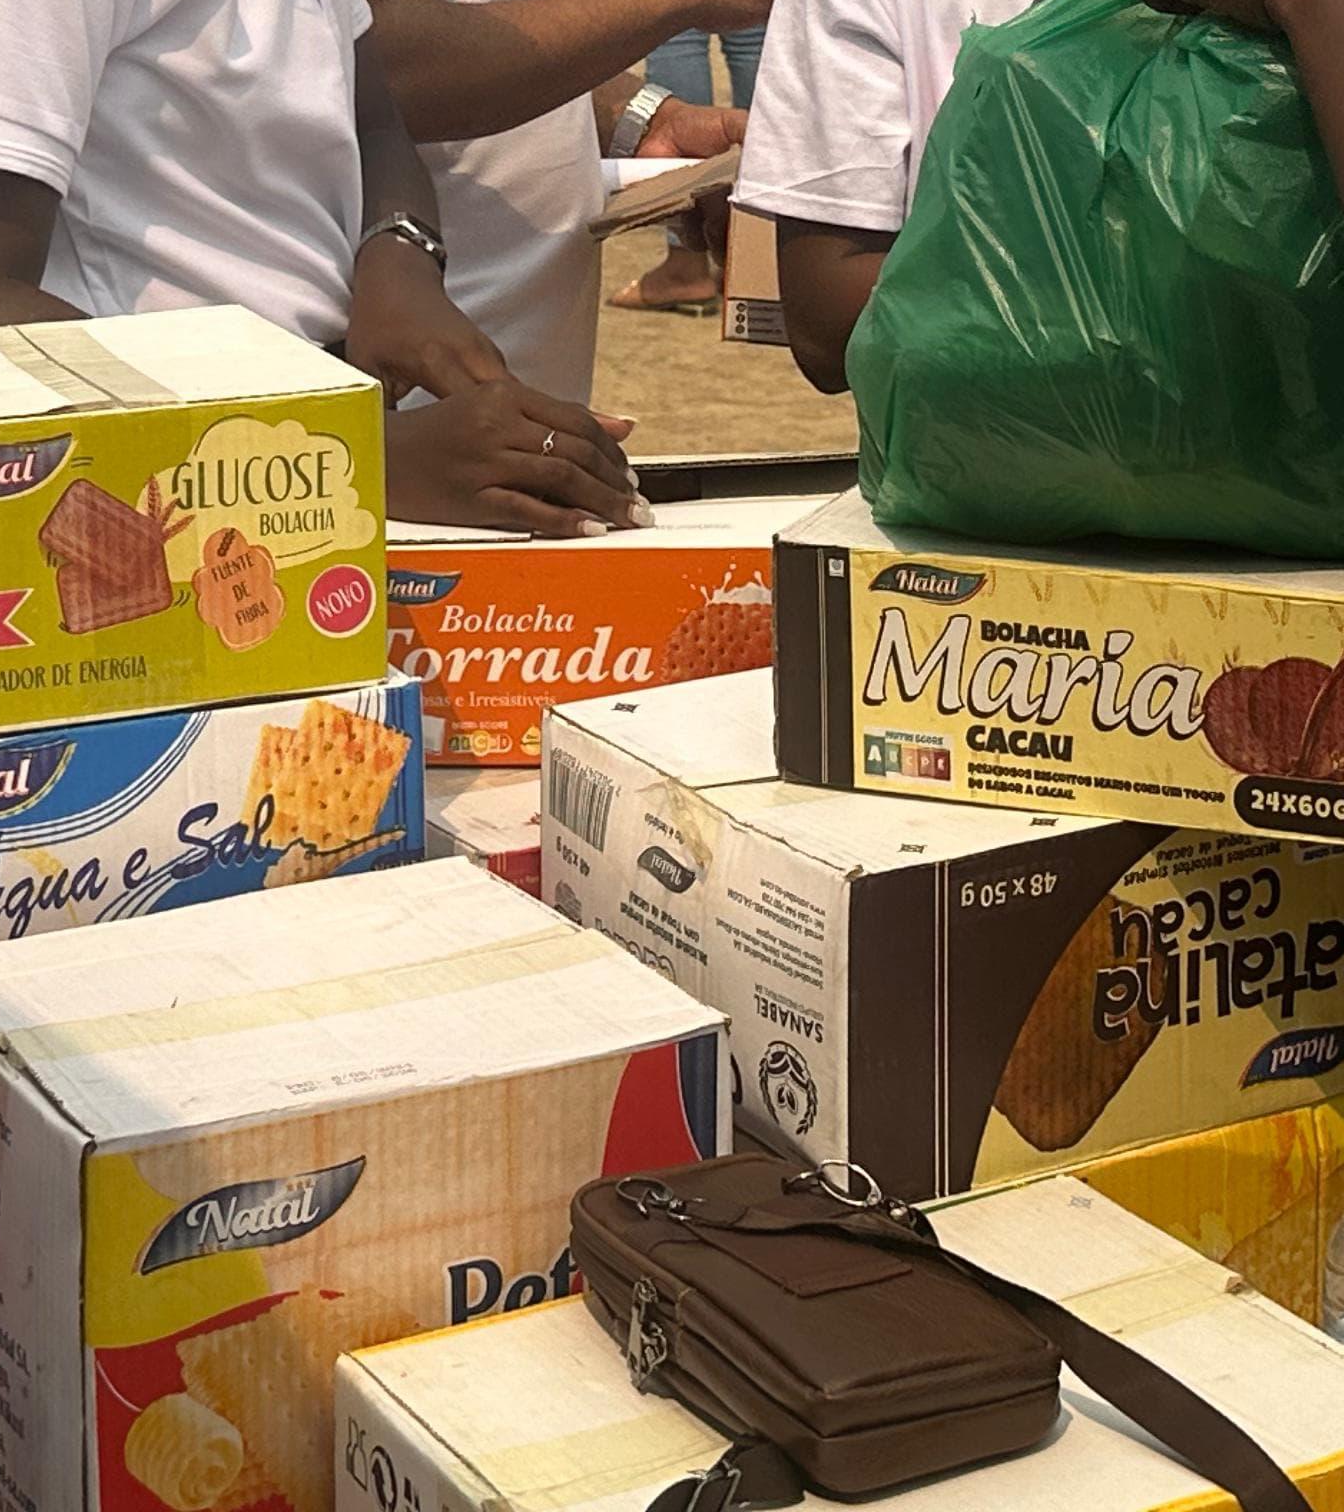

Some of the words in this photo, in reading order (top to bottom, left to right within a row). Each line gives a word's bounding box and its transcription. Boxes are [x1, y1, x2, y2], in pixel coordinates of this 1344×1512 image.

[171, 449, 334, 511] GLUCOSE
[259, 507, 336, 537] BOLACHA
[232, 580, 251, 603] DE
[895, 569, 961, 597] Natal
[235, 601, 271, 627] FIBRA
[315, 579, 366, 622] NOVO
[438, 603, 577, 634] Bolacha
[979, 619, 1092, 651] BOLACHA
[51, 662, 73, 687] DE
[78, 654, 149, 684] ENERGIA
[862, 606, 1207, 742] Maria
[454, 696, 465, 708] e
[867, 744, 882, 761] A
[965, 724, 1075, 763] CACAU
[1025, 784, 1034, 796] A
[122, 846, 156, 889] e
[167, 792, 279, 881] Sal
[959, 880, 976, 908] g
[979, 881, 1007, 908] 50
[1011, 876, 1026, 893] x
[1029, 870, 1057, 898] 48
[1108, 867, 1282, 962] cacau
[753, 993, 824, 1044] SANABEL
[1269, 1032, 1340, 1074] Natal
[186, 1184, 321, 1245] Natal
